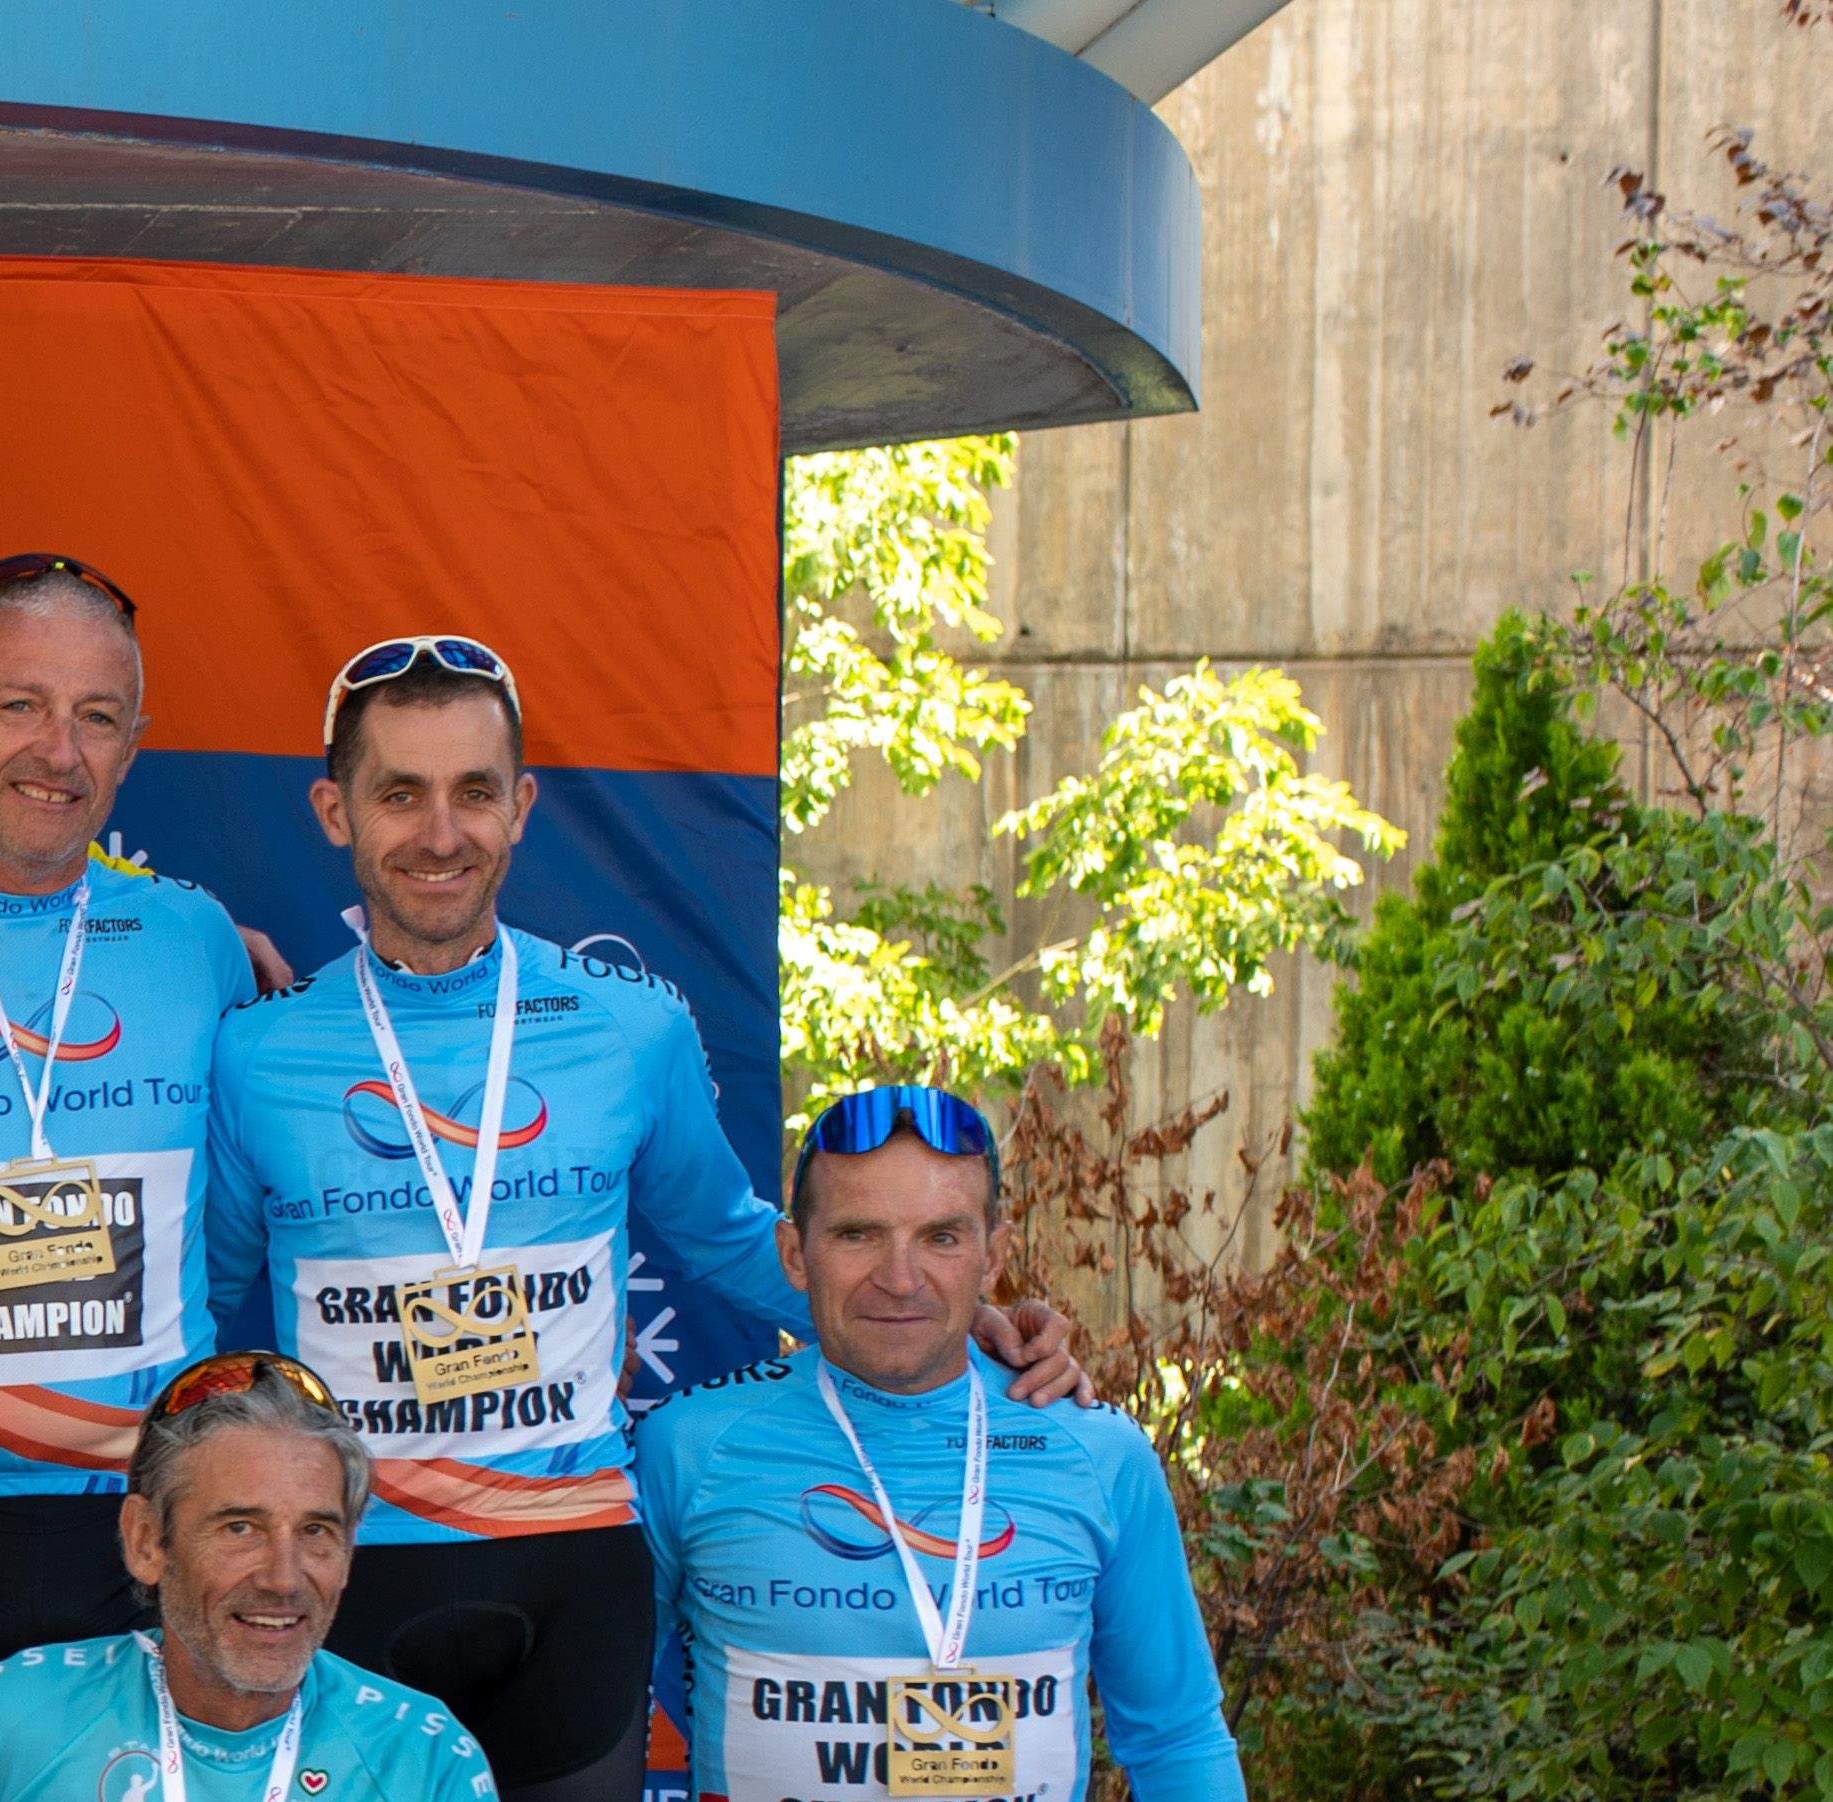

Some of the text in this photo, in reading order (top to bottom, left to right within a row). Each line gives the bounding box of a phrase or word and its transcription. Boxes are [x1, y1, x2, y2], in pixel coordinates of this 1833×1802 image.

[59, 918, 143, 934] FOFACTORS
[427, 964, 488, 995] World
[477, 995, 580, 1020] FOFACTORS
[142, 1077, 204, 1106] Tour
[434, 1359, 471, 1377] Gran
[946, 1435, 1049, 1451] FOFACTORS
[769, 1579, 895, 1612] Fondo
[932, 1580, 1025, 1610] rld
[752, 1676, 889, 1724] GRAN
[910, 1757, 1000, 1771] Gran Fondo
